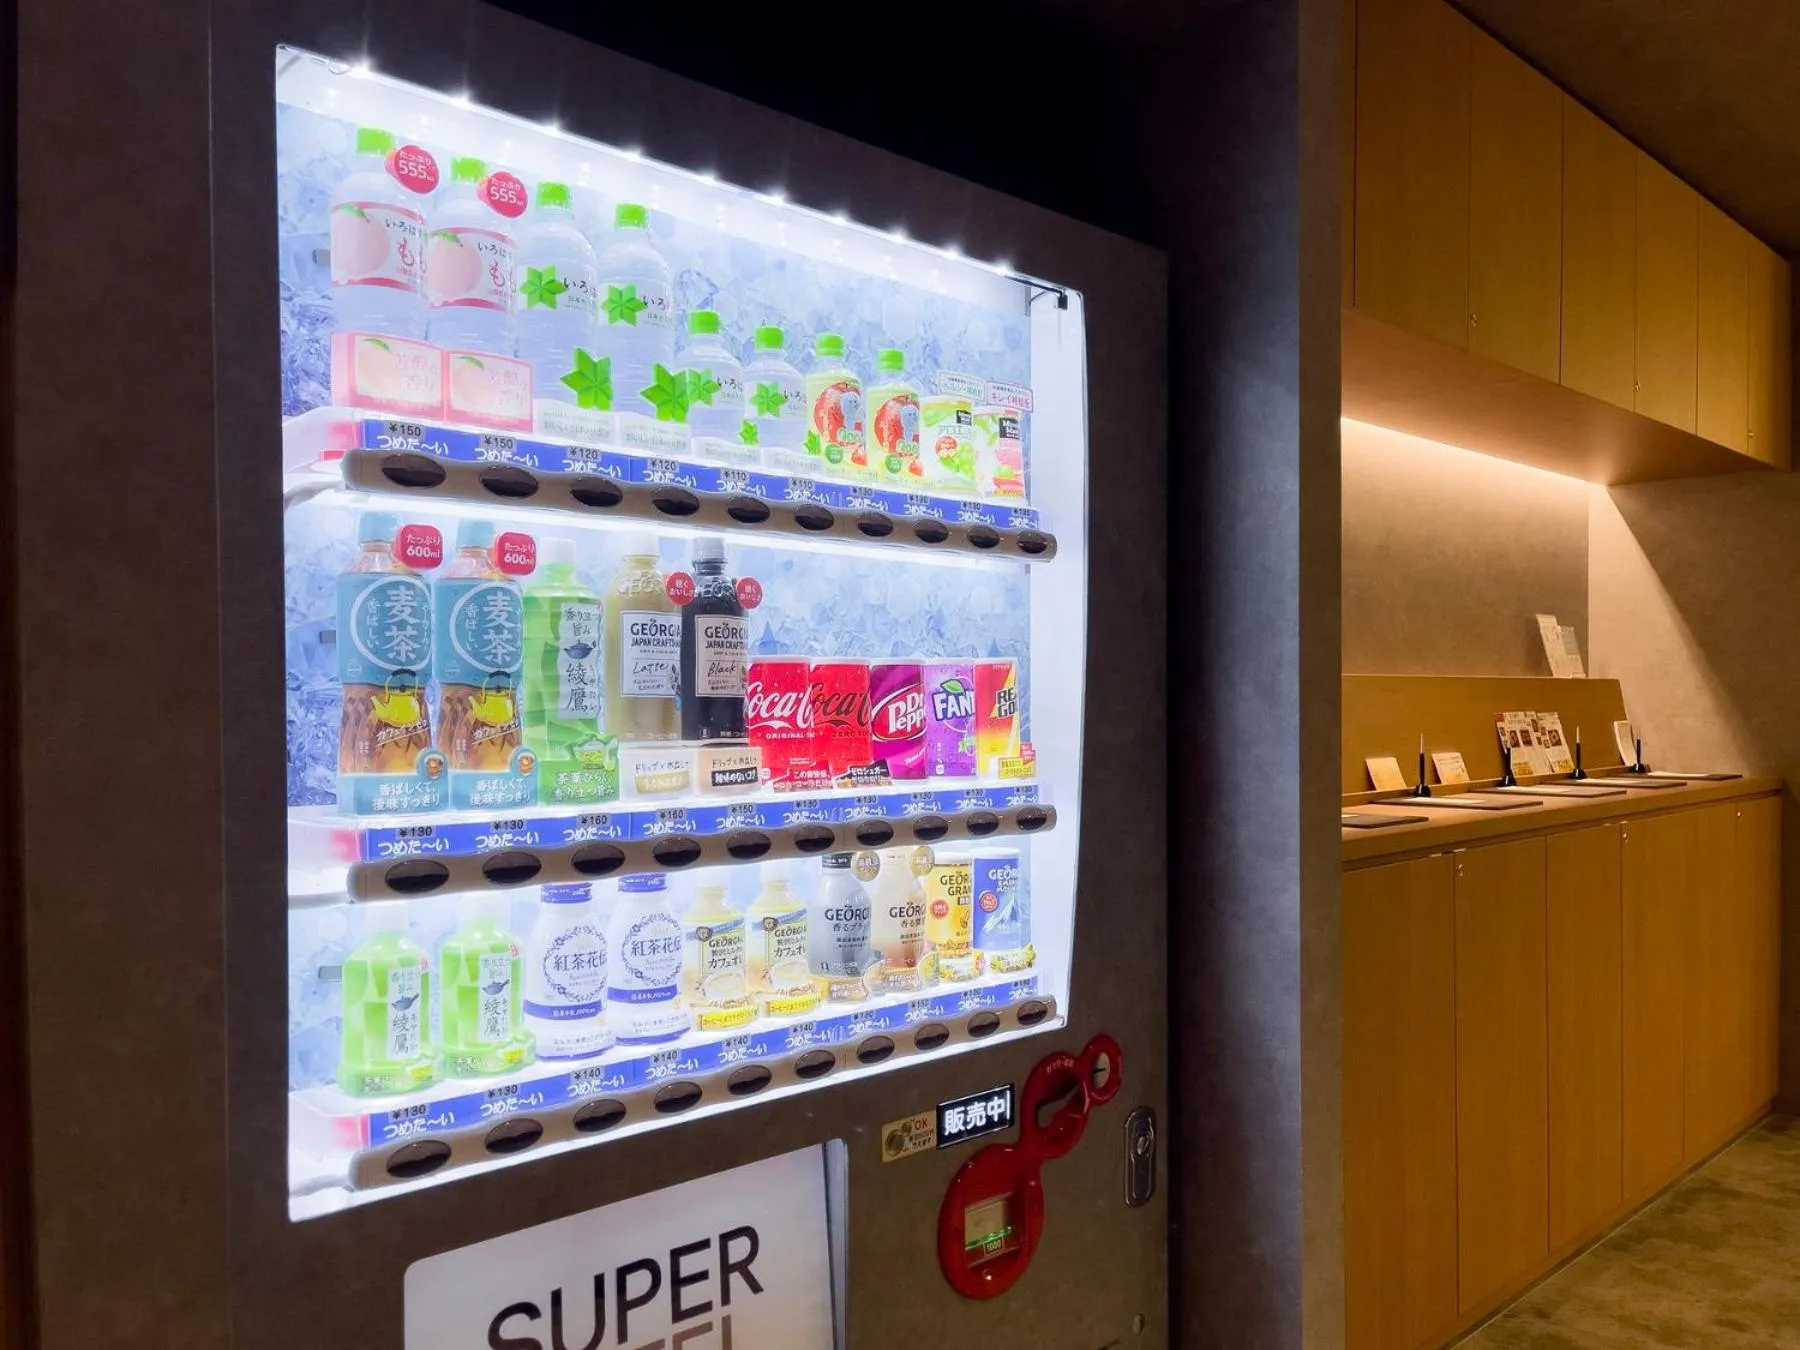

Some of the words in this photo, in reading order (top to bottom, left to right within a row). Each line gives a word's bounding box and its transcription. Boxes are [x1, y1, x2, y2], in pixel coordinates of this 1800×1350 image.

[389, 422, 421, 437] ¥150
[485, 436, 513, 449] ¥150
[570, 447, 599, 460] ¥120
[651, 459, 676, 471] ¥120
[406, 534, 441, 545] たっぷり
[406, 546, 440, 558] 600ml
[504, 542, 535, 553] たっぷり
[365, 598, 381, 649] 香ばしい
[382, 585, 423, 663] 麦茶
[479, 592, 519, 665] 麦茶
[707, 661, 737, 677] Black
[566, 662, 588, 713] 綾鷹
[765, 731, 805, 740] ORIGINAL
[493, 819, 523, 831] ¥130
[580, 815, 608, 825] ¥160
[399, 826, 433, 838] ¥130
[483, 998, 501, 1037] 綾鷹
[726, 1036, 749, 1047] ¥140
[653, 1051, 678, 1063] ¥140
[574, 1067, 601, 1080] ¥140
[487, 1084, 518, 1099] ¥130
[392, 1104, 426, 1120] ¥130
[943, 1096, 1006, 1136] 販売中
[914, 1117, 929, 1131] OK
[487, 1225, 764, 1350] SUPER
